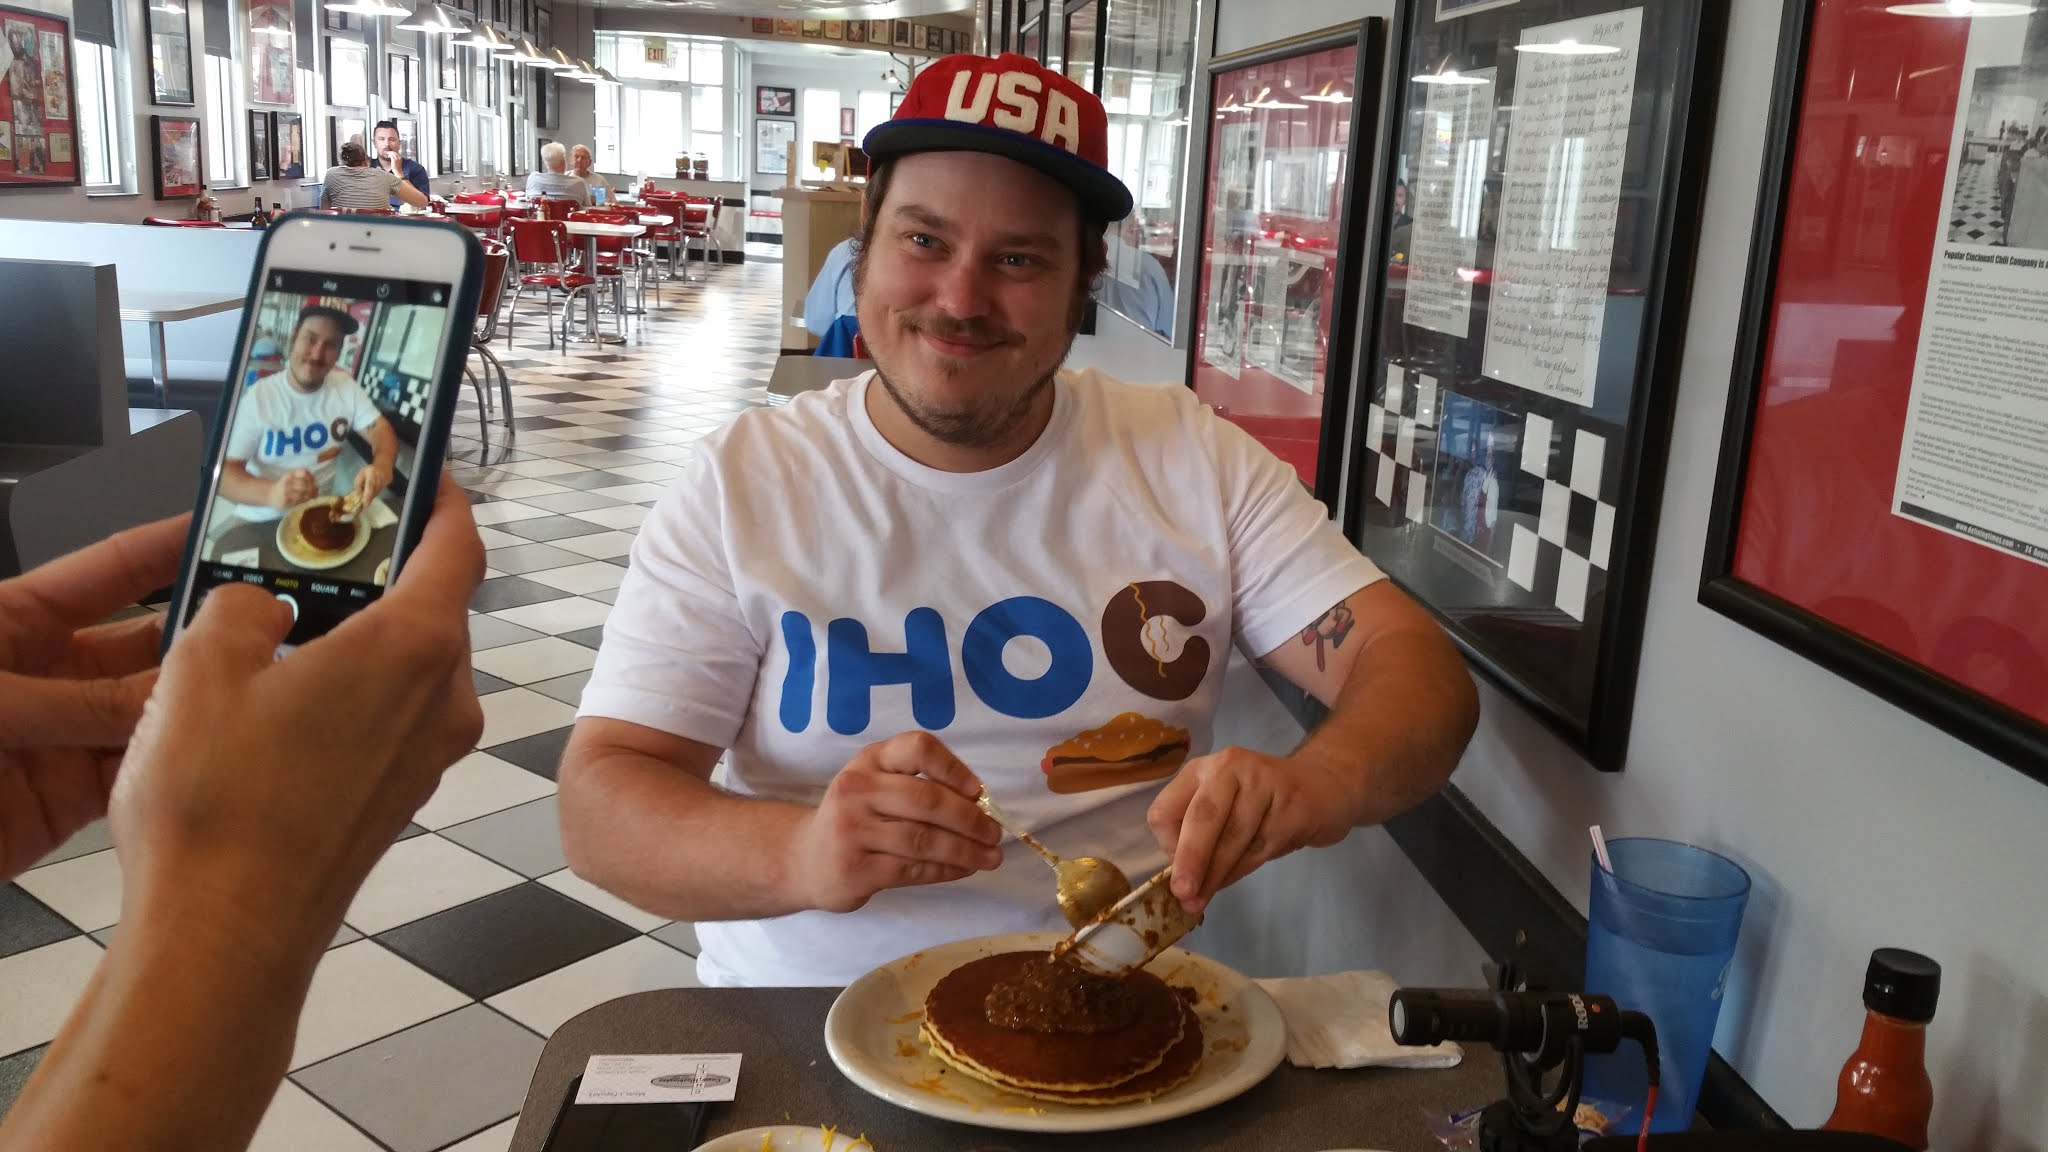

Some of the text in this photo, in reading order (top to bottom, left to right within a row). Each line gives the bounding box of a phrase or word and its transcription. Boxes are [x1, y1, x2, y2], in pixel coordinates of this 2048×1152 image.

[647, 47, 664, 61] EXIT
[944, 69, 1080, 155] USA
[1944, 250, 1965, 260] Popular
[1965, 252, 1995, 263] Cincinnati
[1995, 254, 2009, 264] Chili
[2009, 256, 2038, 268] Company
[243, 573, 264, 584] VIDEO
[275, 577, 299, 588] PHOTO
[310, 582, 340, 595] SQUARE
[779, 580, 1210, 735] IHOC
